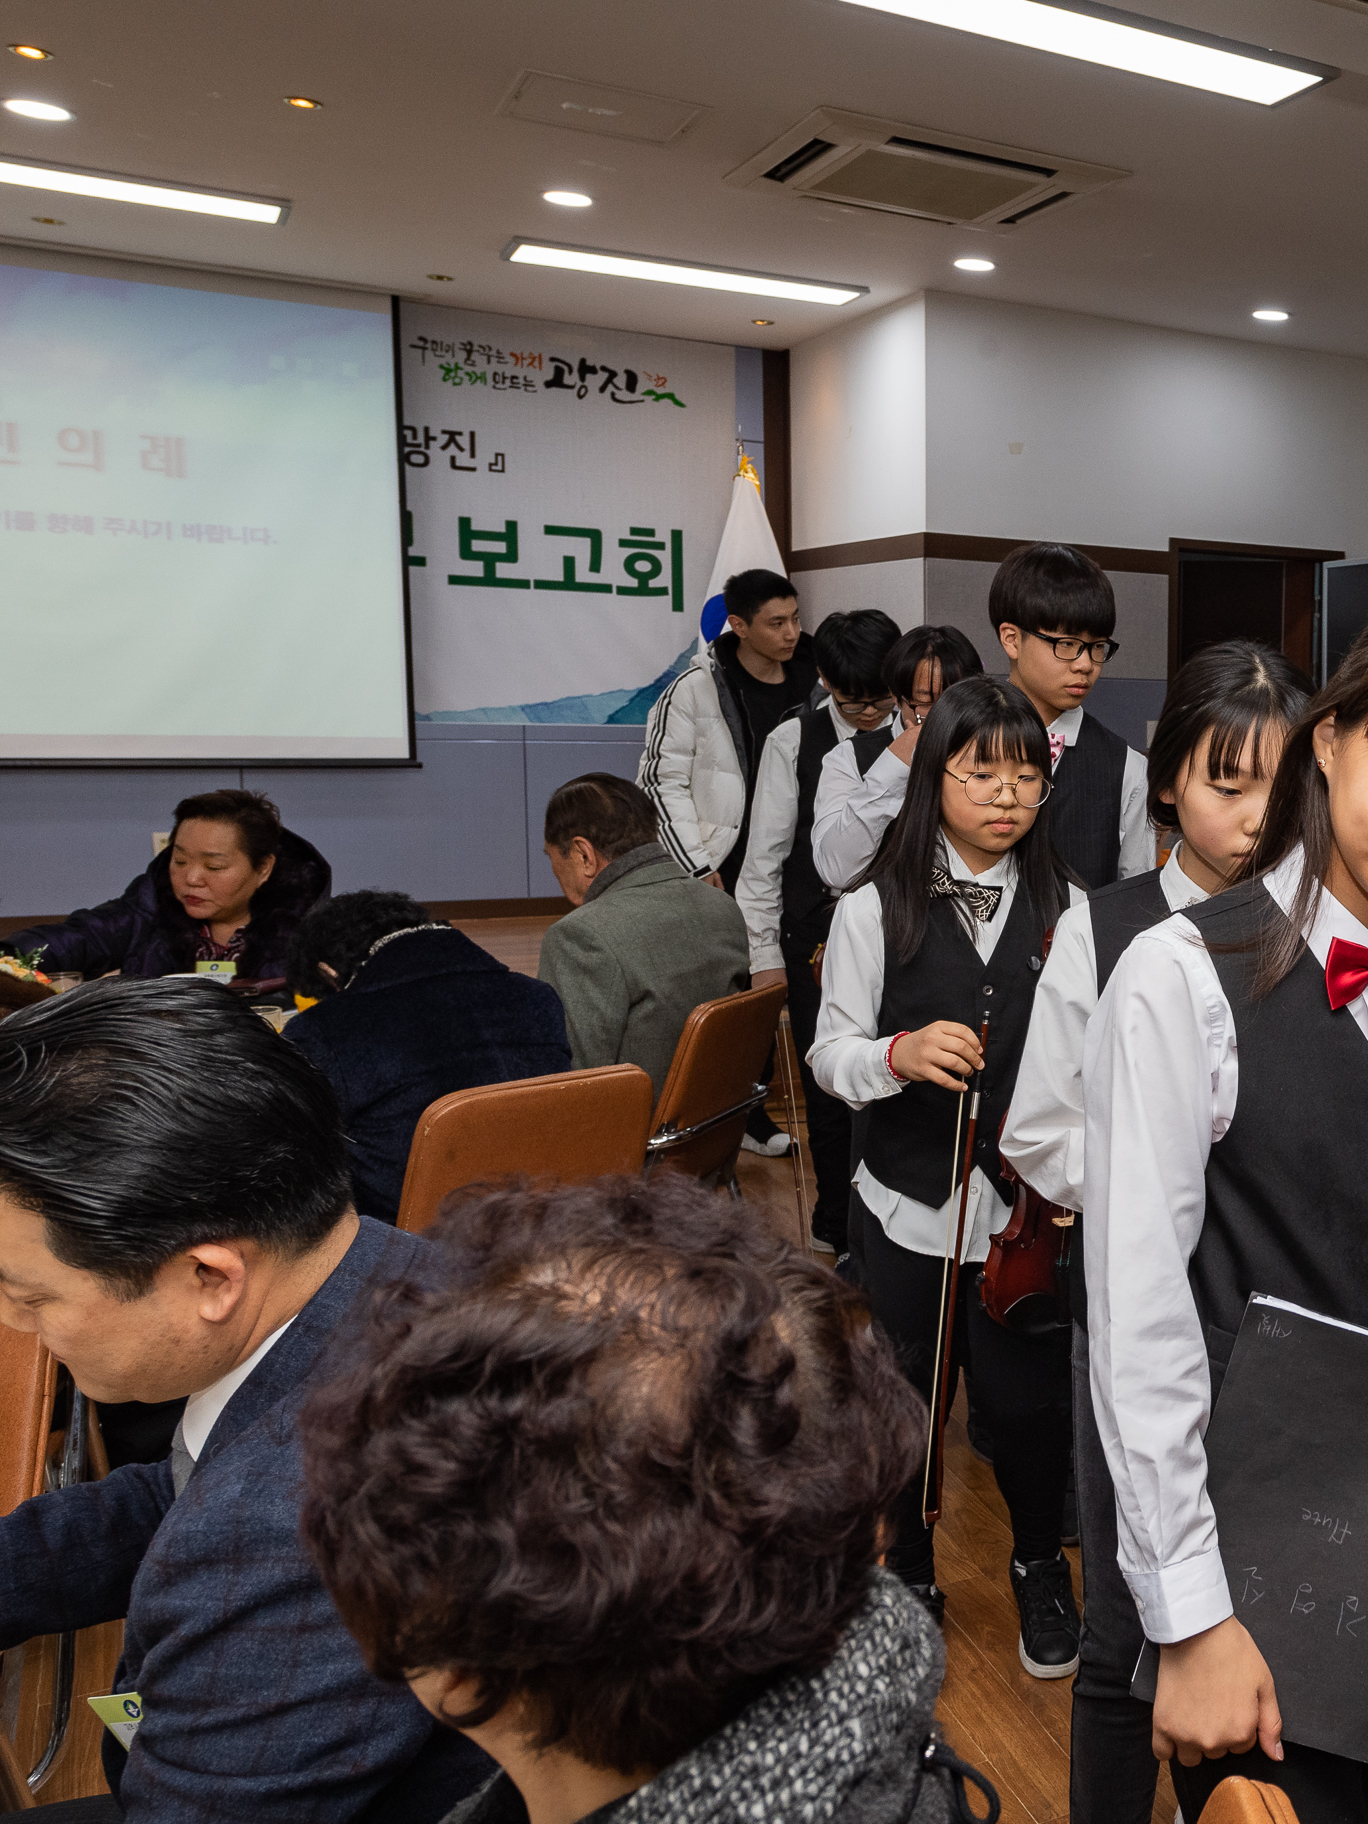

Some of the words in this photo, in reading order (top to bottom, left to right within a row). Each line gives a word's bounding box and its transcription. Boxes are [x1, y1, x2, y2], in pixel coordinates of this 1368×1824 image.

[458, 340, 509, 367] 꿈꾸는
[509, 351, 543, 371] 가치
[438, 361, 488, 387] 함께
[491, 371, 538, 394] 만드는
[543, 356, 645, 404] 광진
[46, 511, 97, 537] 향해
[102, 516, 174, 542] 주시기
[447, 515, 684, 613] 보고회
